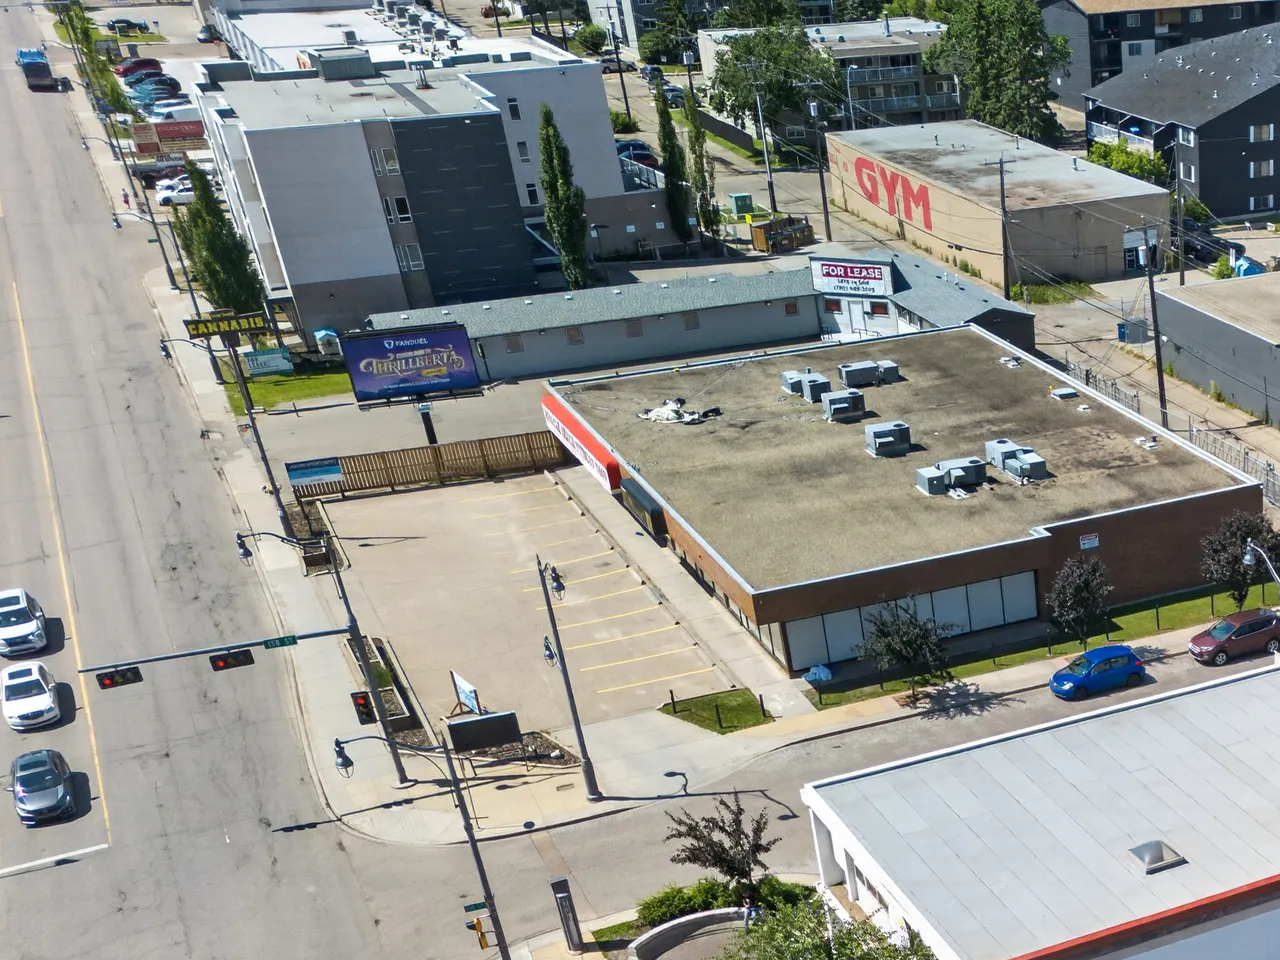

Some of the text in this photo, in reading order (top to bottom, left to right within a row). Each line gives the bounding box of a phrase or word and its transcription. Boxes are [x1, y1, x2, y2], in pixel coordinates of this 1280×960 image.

[854, 157, 932, 231] GYM
[822, 265, 882, 279] FOR LEASE
[188, 316, 264, 335] CANNABIS
